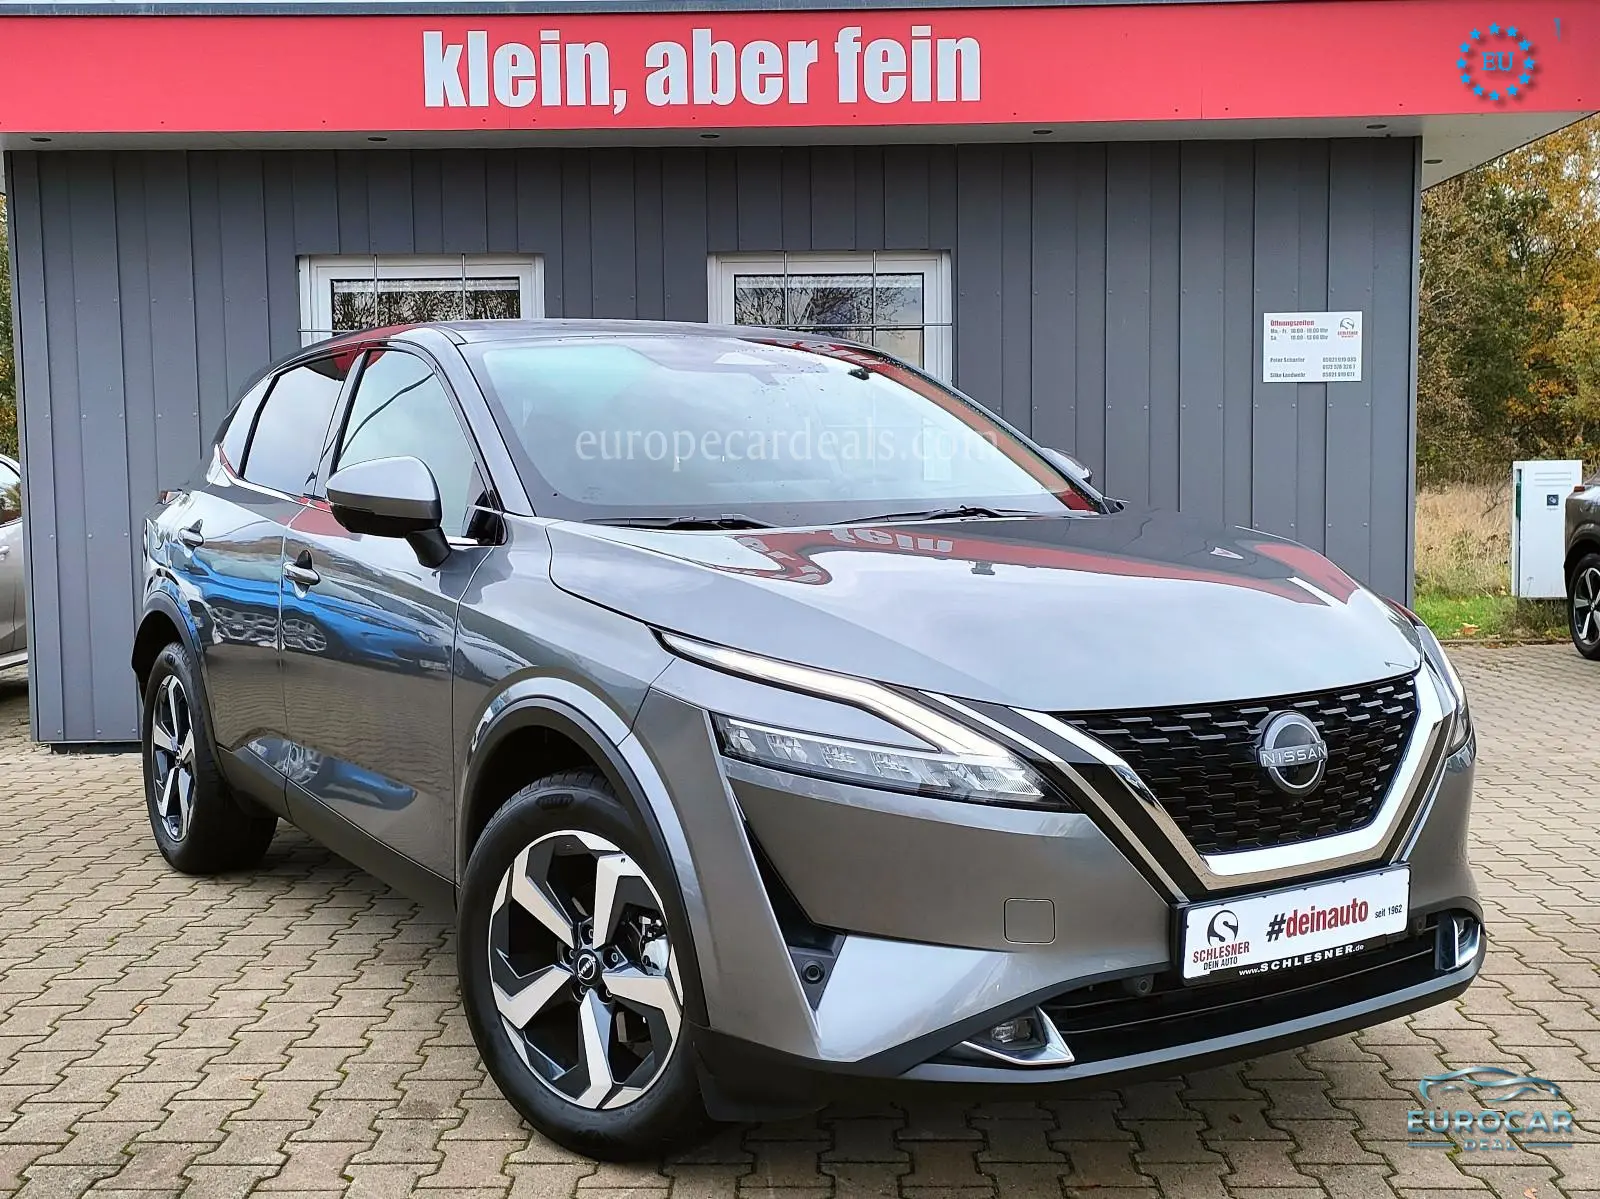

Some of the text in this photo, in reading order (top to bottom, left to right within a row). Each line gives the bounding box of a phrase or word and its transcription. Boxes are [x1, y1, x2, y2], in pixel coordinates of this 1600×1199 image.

[422, 24, 982, 116] klein, aber fein
[1262, 746, 1327, 767] NISSAN
[1266, 897, 1403, 943] #deinauto seit 1962
[1192, 941, 1250, 964] SCHLESNER
[1203, 957, 1238, 971] DEIN AUTO
[1238, 943, 1364, 977] www.SCHLESNER.de
